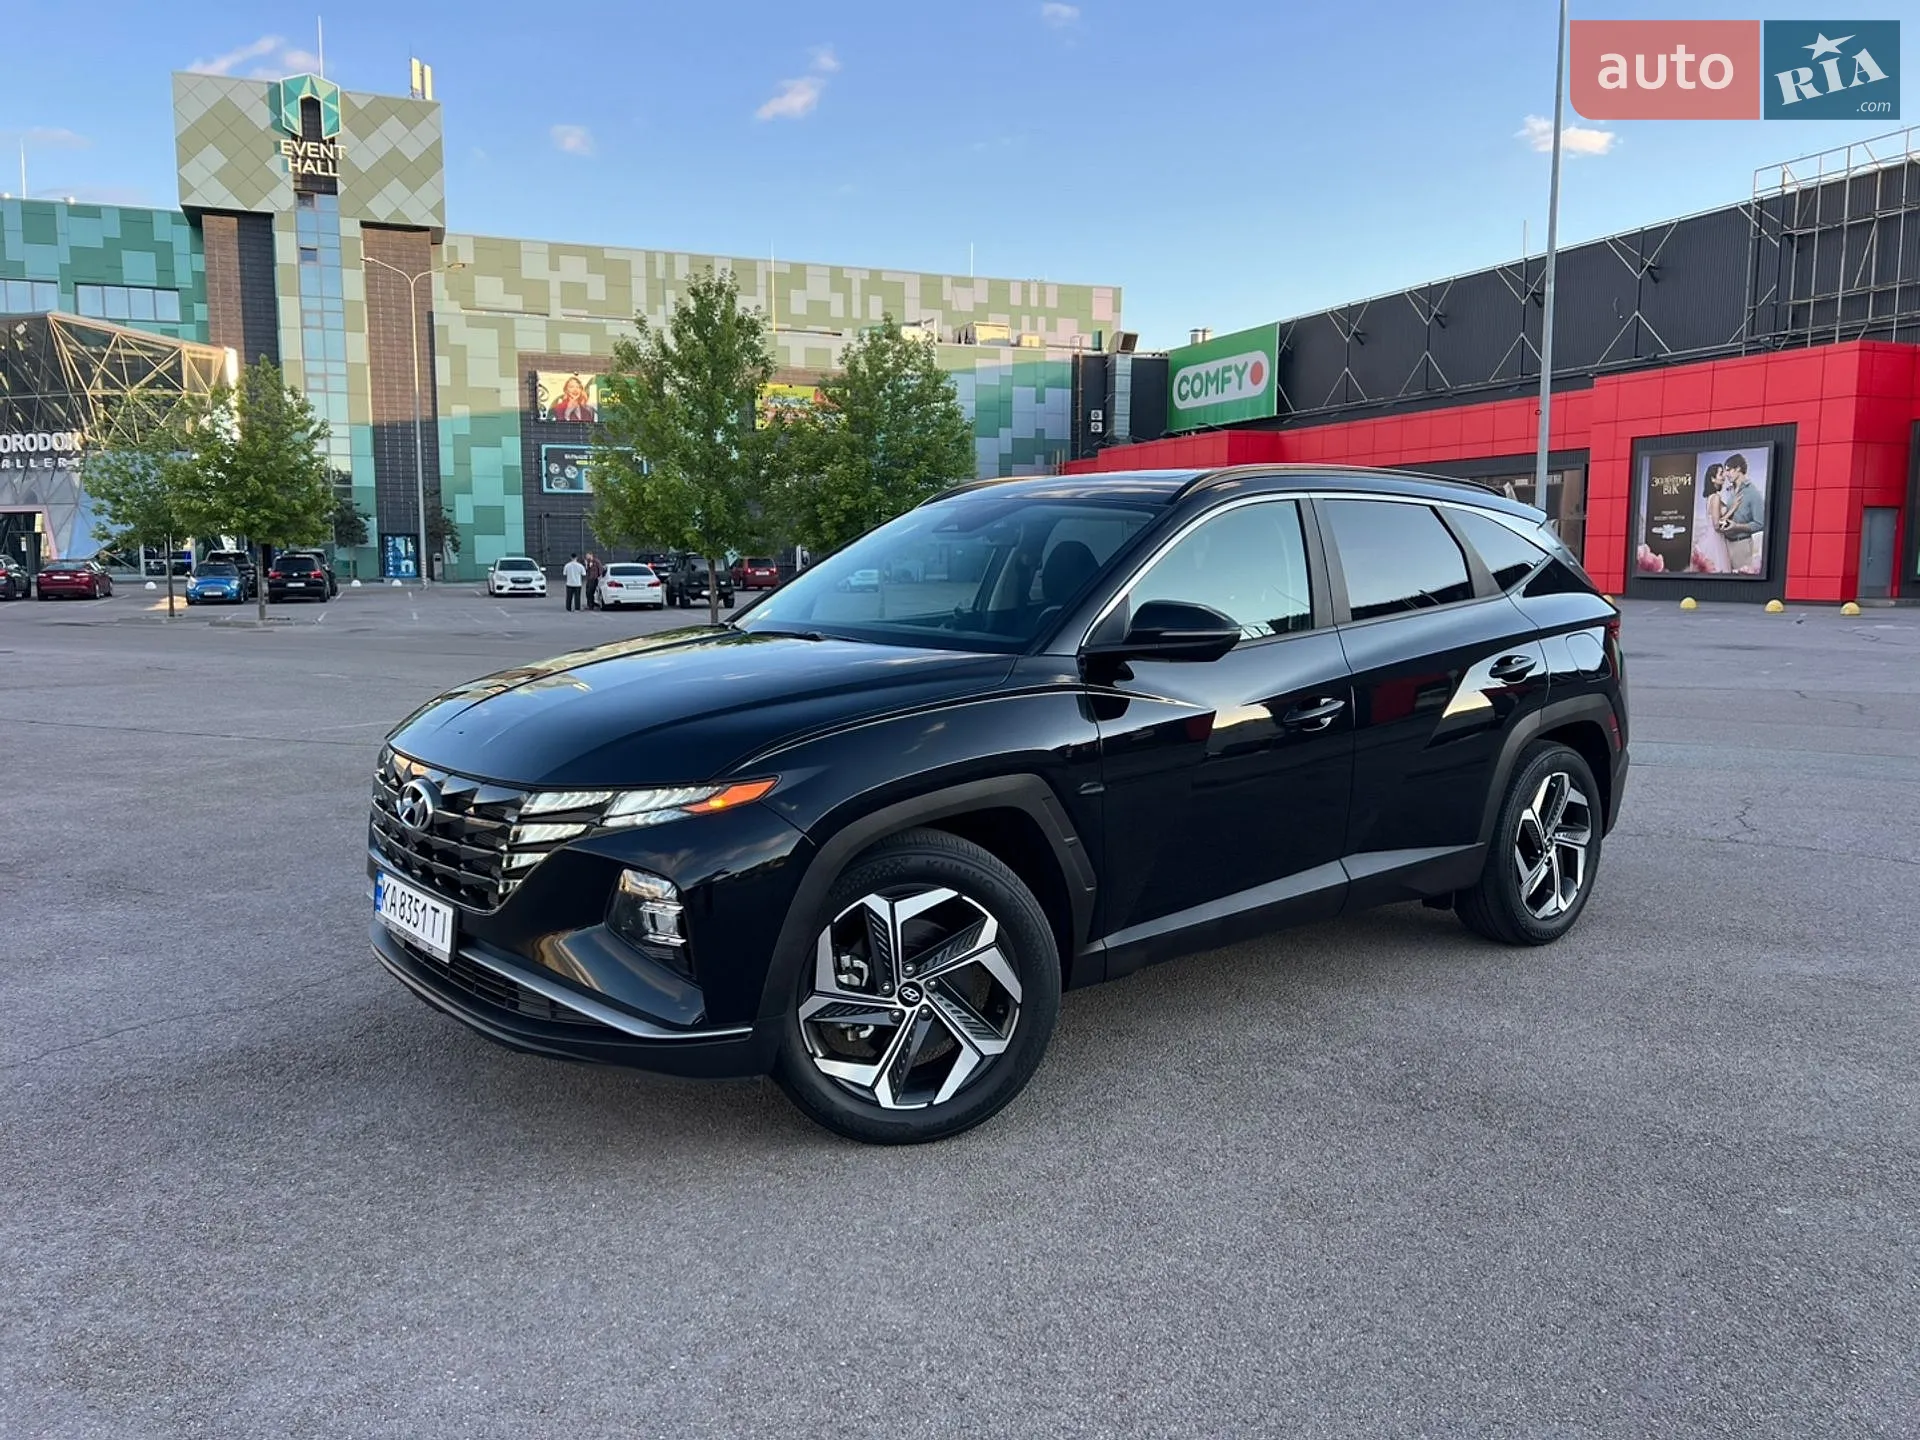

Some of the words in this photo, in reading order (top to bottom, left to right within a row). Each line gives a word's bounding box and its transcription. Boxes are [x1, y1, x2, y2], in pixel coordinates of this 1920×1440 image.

[280, 139, 346, 160] EVENT
[287, 157, 341, 176] HALL
[1177, 361, 1248, 402] COMFY
